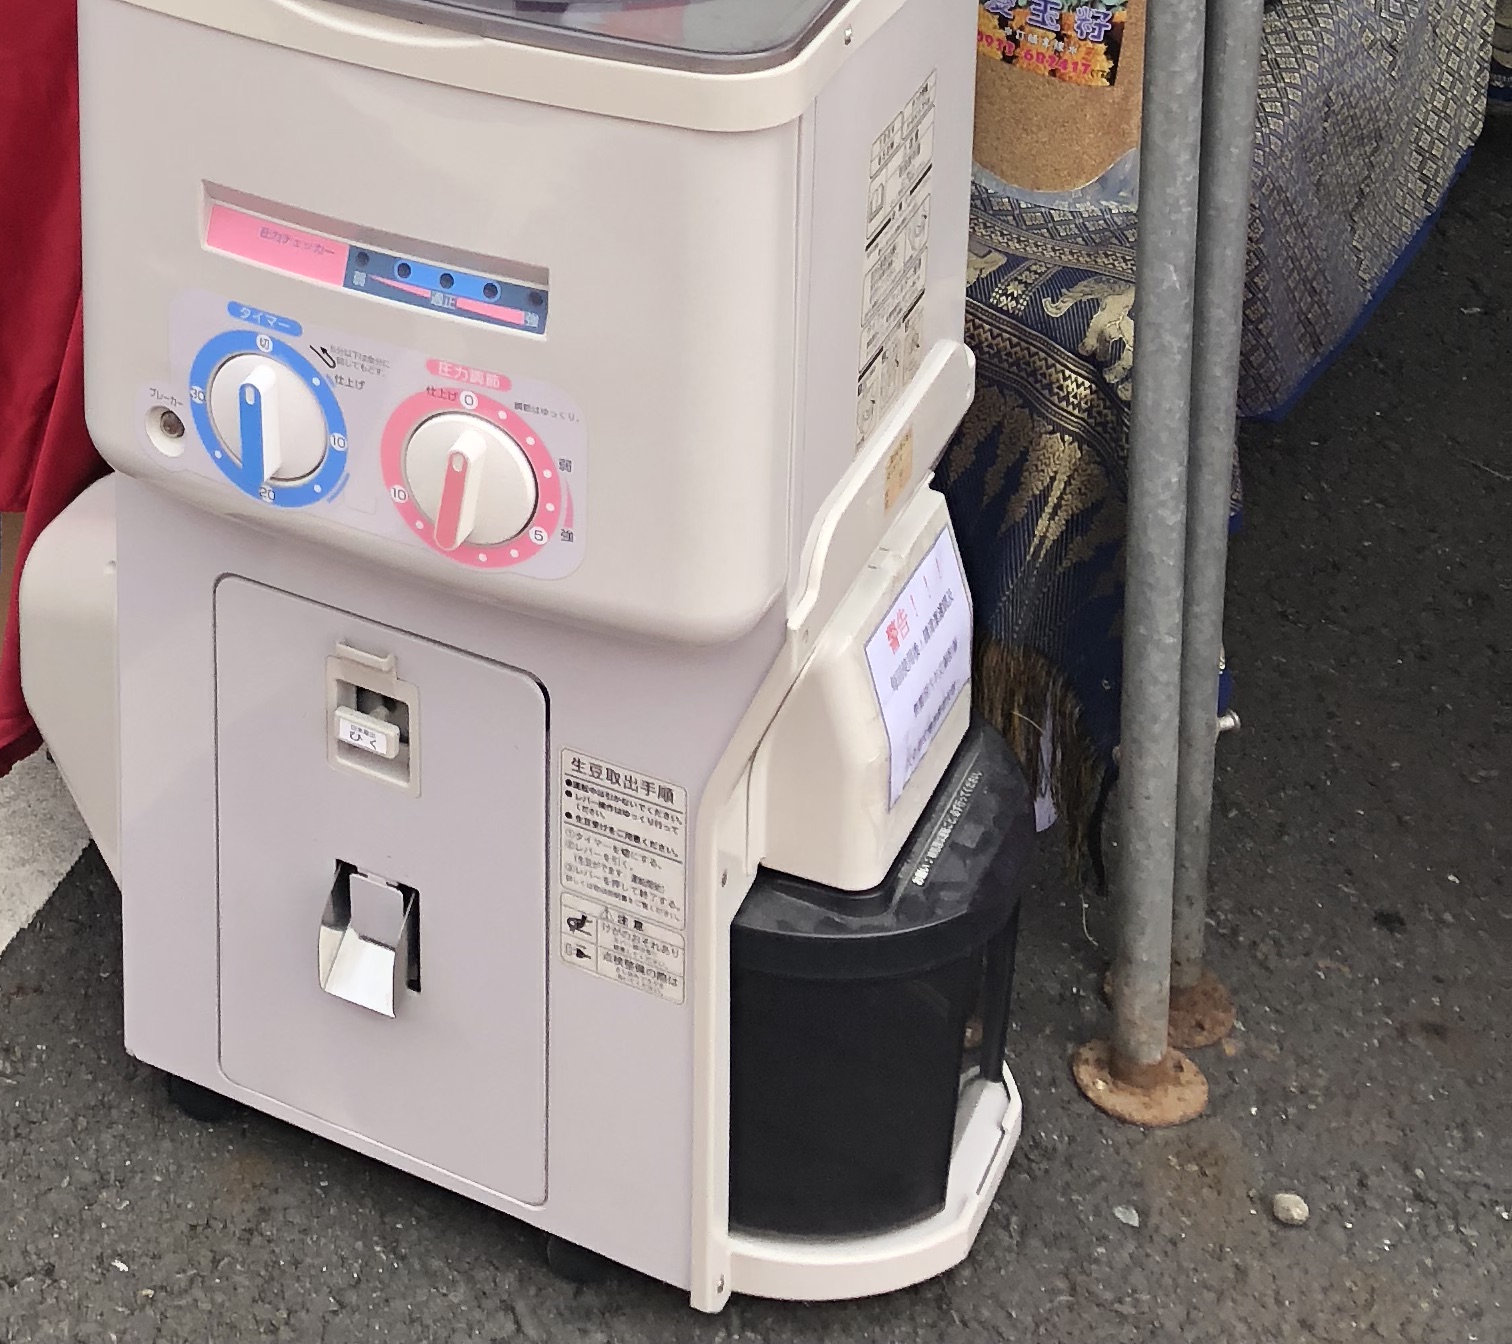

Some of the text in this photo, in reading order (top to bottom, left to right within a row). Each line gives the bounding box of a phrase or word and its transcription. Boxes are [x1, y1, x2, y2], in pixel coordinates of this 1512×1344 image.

[259, 226, 336, 256] 圧力チェッカー
[240, 306, 291, 329] タイマー
[259, 337, 271, 350] 切
[334, 374, 366, 391] 仕上げ
[437, 362, 501, 389] 圧力調節
[149, 387, 184, 407] ブレーカー
[189, 388, 206, 402] 30
[426, 385, 475, 407] 仕上げ 0
[331, 435, 347, 449] 10
[259, 487, 276, 501] 20
[392, 487, 407, 502] 10
[533, 529, 544, 542] 5
[570, 756, 675, 804] 生豆取出手順
[601, 922, 680, 959] けがのおそれあり
